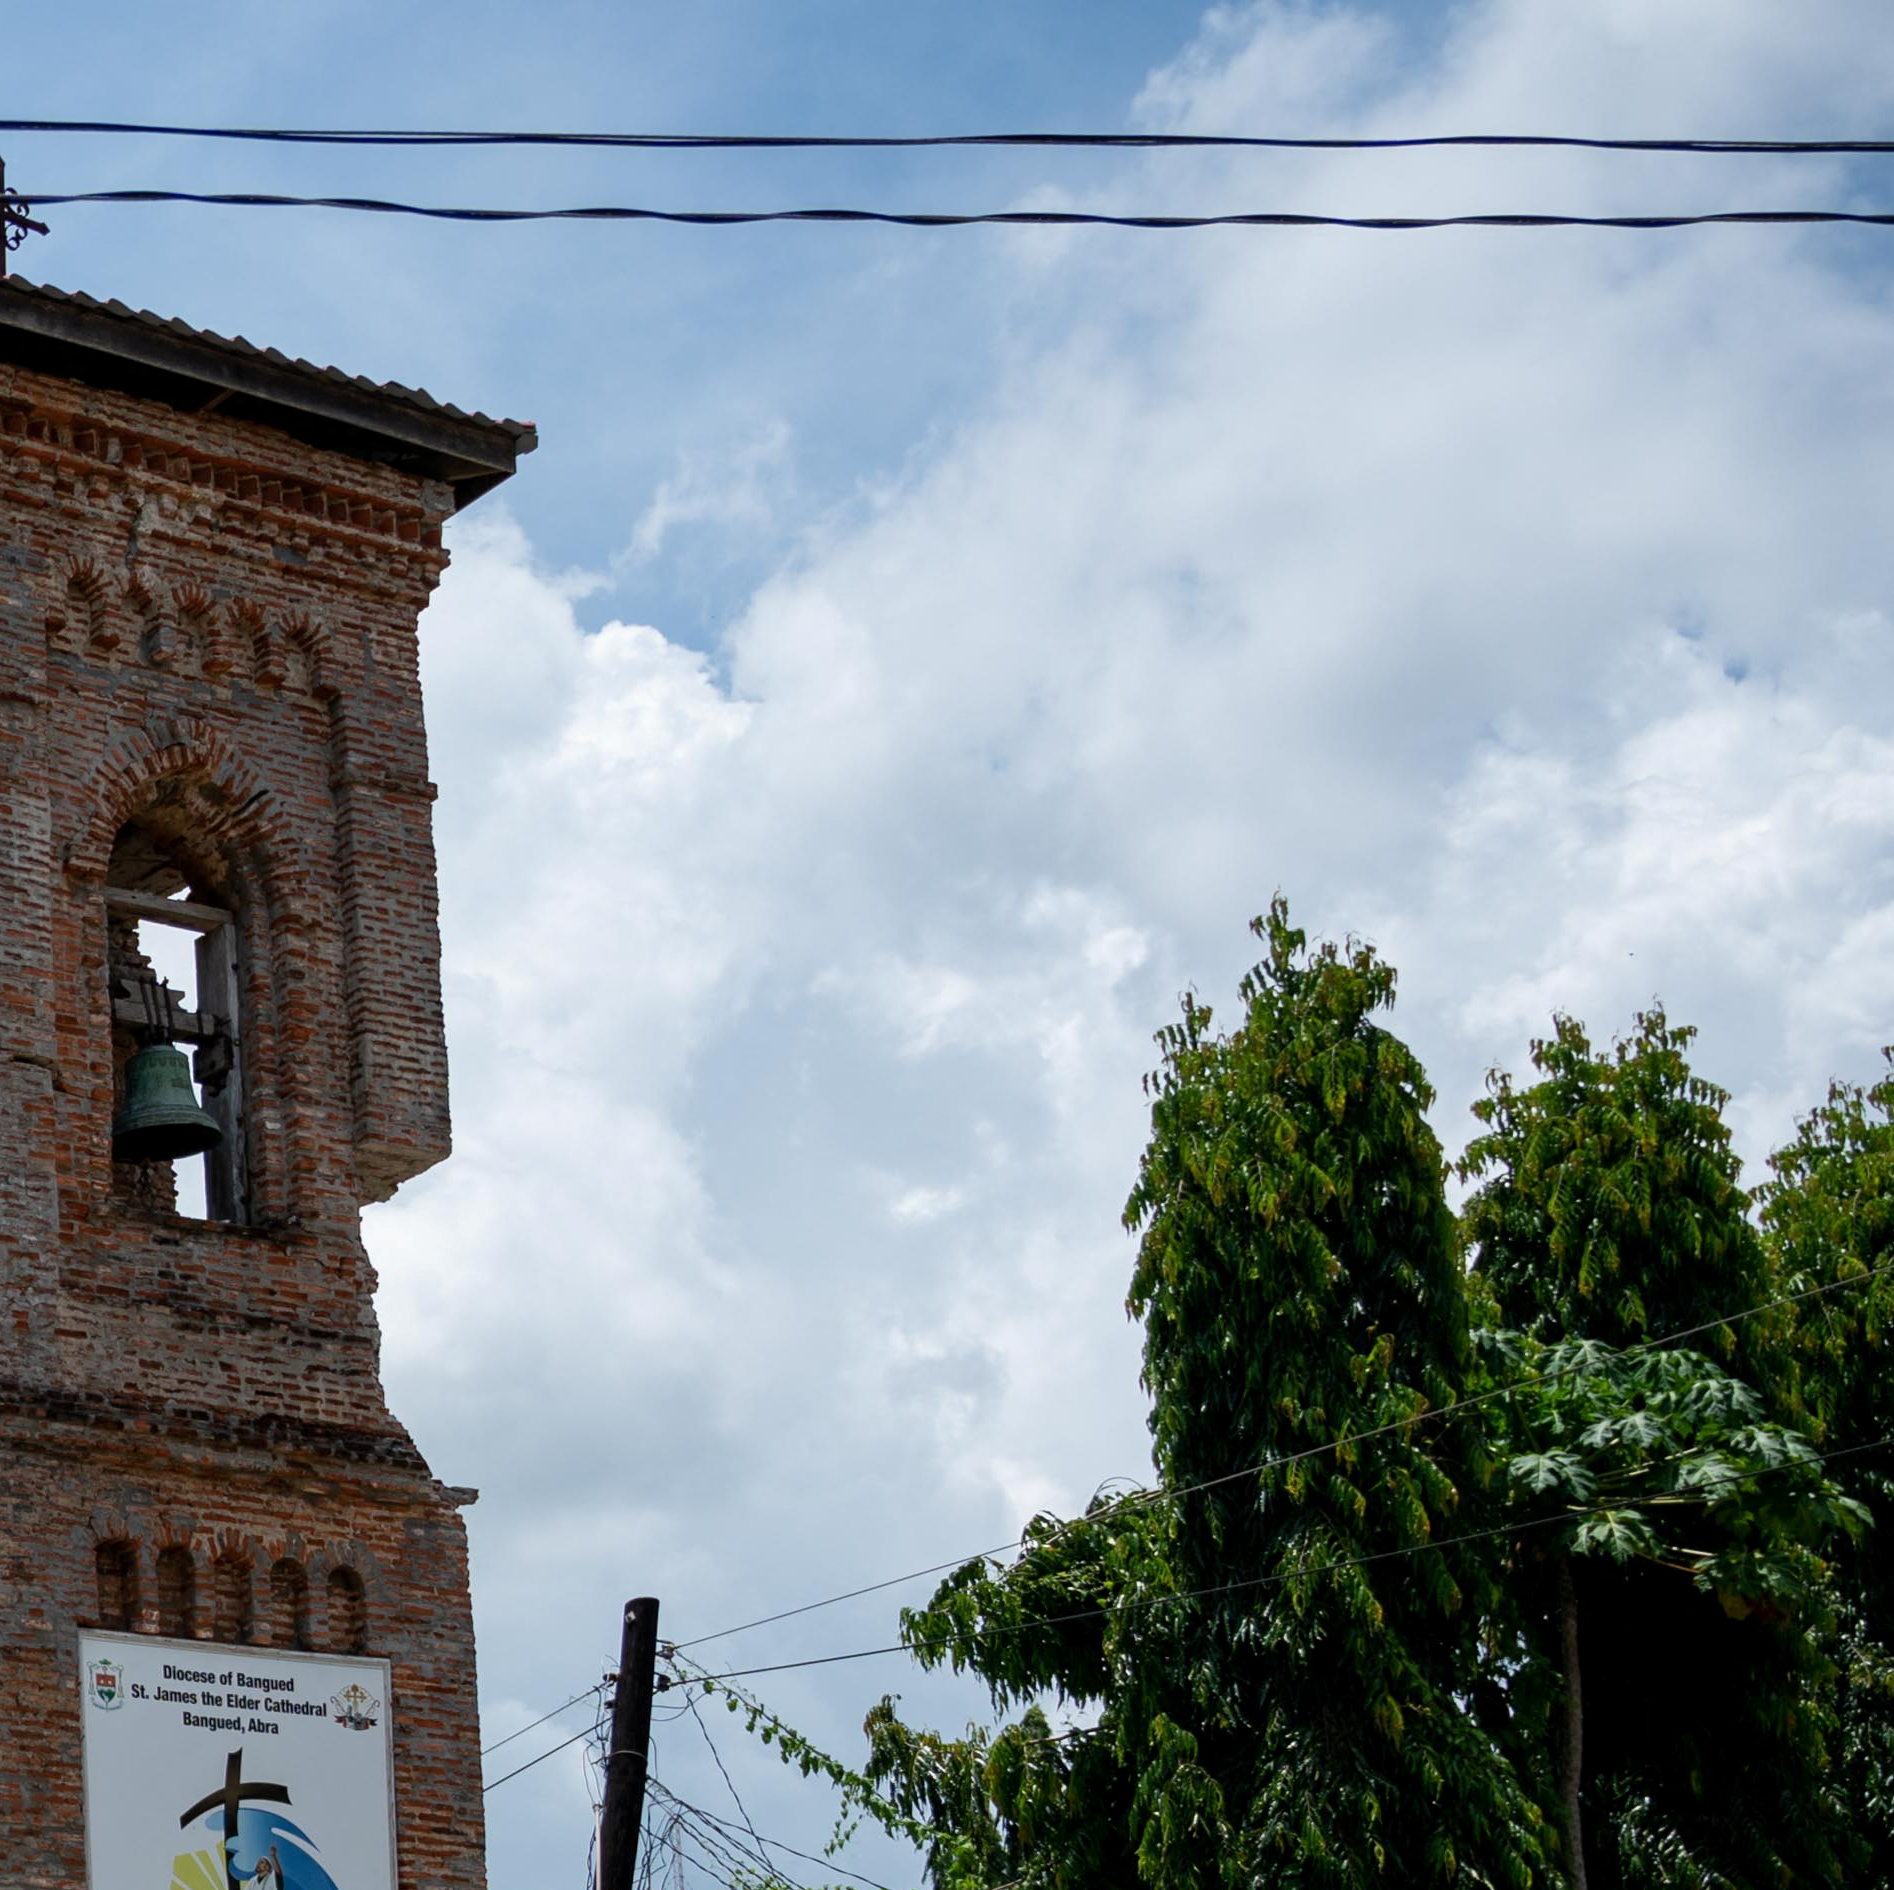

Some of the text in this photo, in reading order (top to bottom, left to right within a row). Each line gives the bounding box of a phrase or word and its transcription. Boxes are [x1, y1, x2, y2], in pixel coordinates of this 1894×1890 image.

[162, 1664, 295, 1693] Diocese of Bangued
[130, 1683, 328, 1718] St. James the Elder Cathedral
[182, 1711, 280, 1735] Bangued, Abra
